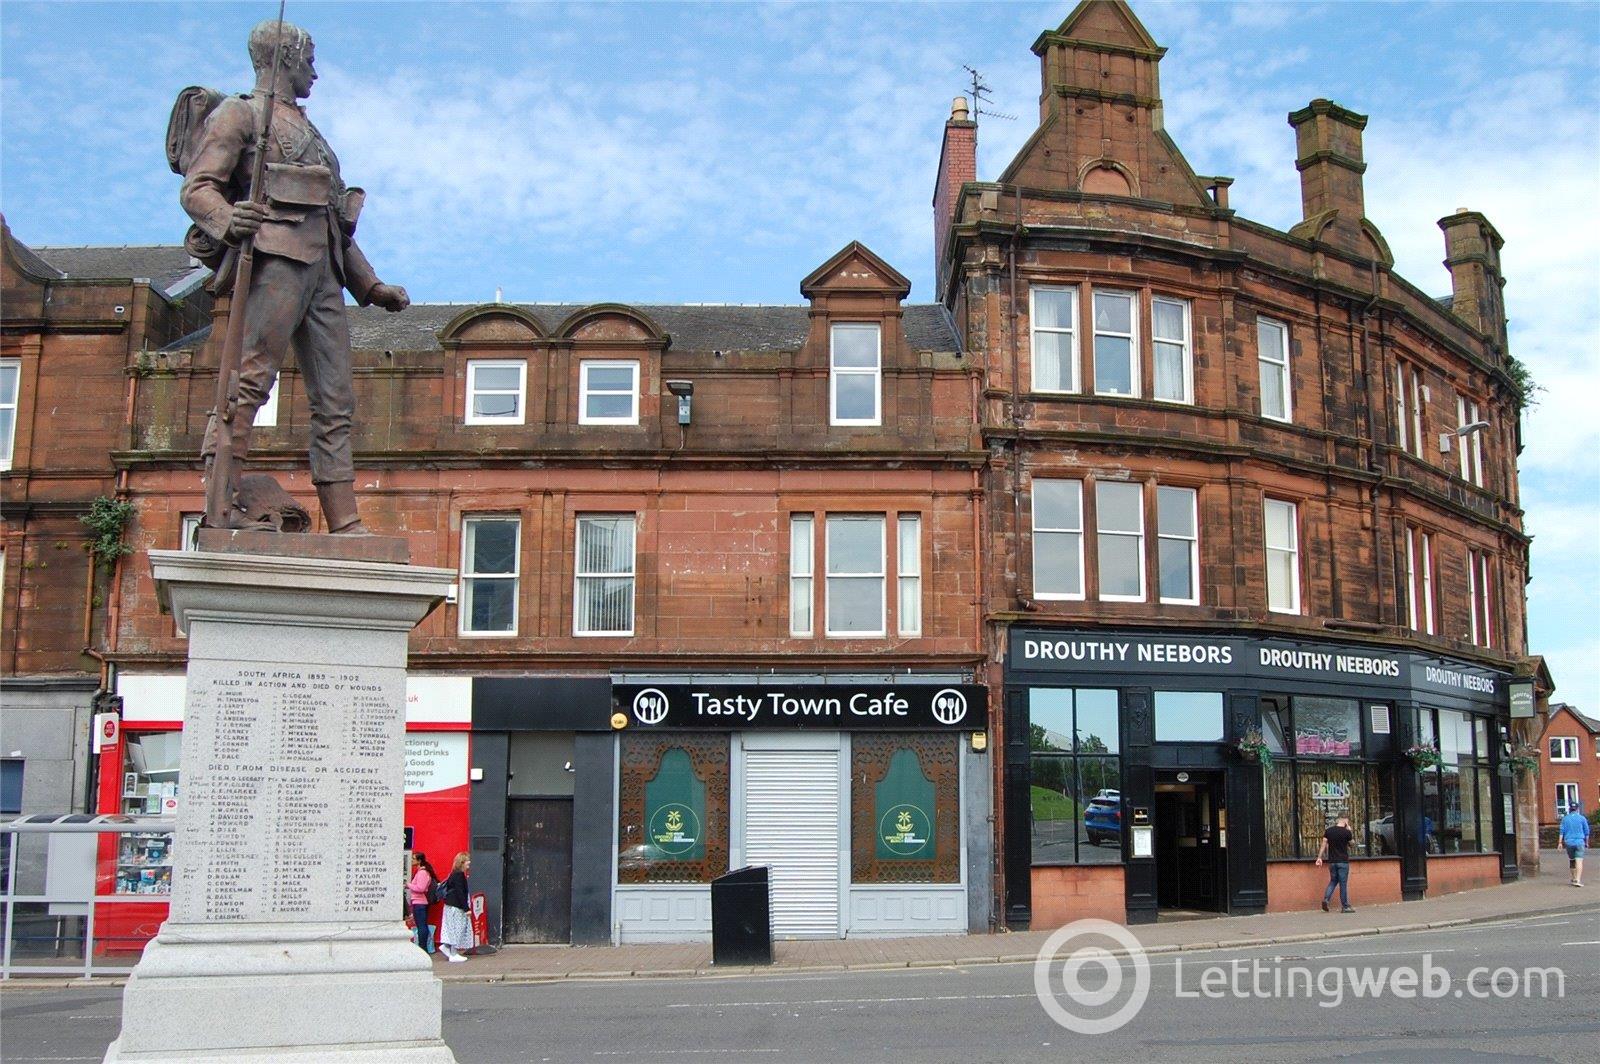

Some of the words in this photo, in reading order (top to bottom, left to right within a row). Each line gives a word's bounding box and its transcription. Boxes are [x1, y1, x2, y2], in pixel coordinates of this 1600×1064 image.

[1025, 641, 1129, 660] DROUTHY
[1138, 644, 1233, 664] NEEBORS
[1260, 648, 1332, 670] DROUTHY
[1337, 655, 1399, 676] NEEBORS
[1426, 667, 1461, 687] DROUTHY
[1463, 674, 1494, 693] NEEBORS
[692, 693, 762, 721] Tasty
[767, 694, 840, 715] Town
[849, 693, 908, 715] Cafe
